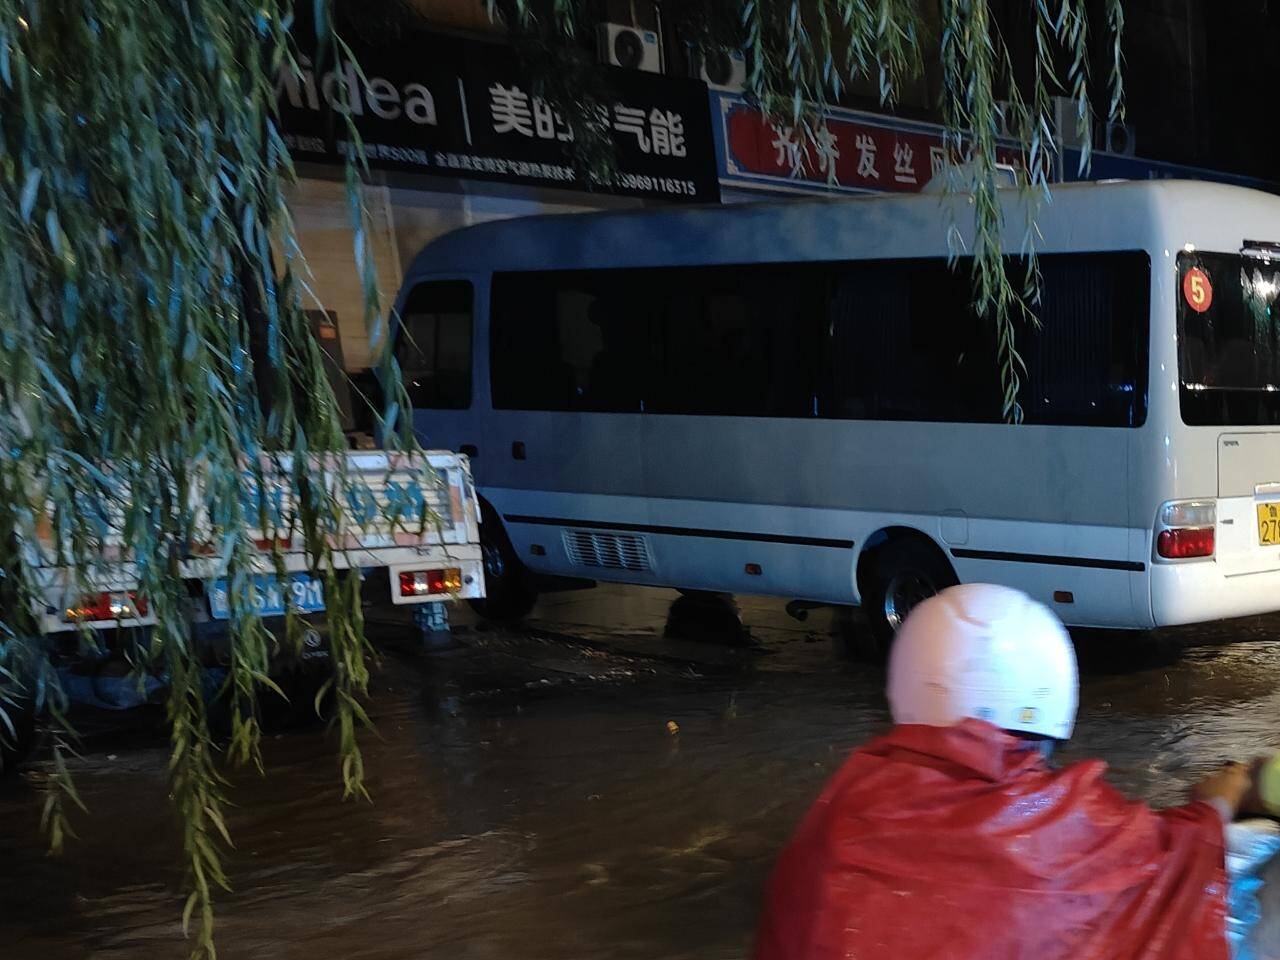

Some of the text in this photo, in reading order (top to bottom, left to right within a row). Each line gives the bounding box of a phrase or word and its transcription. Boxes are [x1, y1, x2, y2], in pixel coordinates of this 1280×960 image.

[487, 81, 688, 158] 美的气能
[1191, 275, 1205, 305] 5
